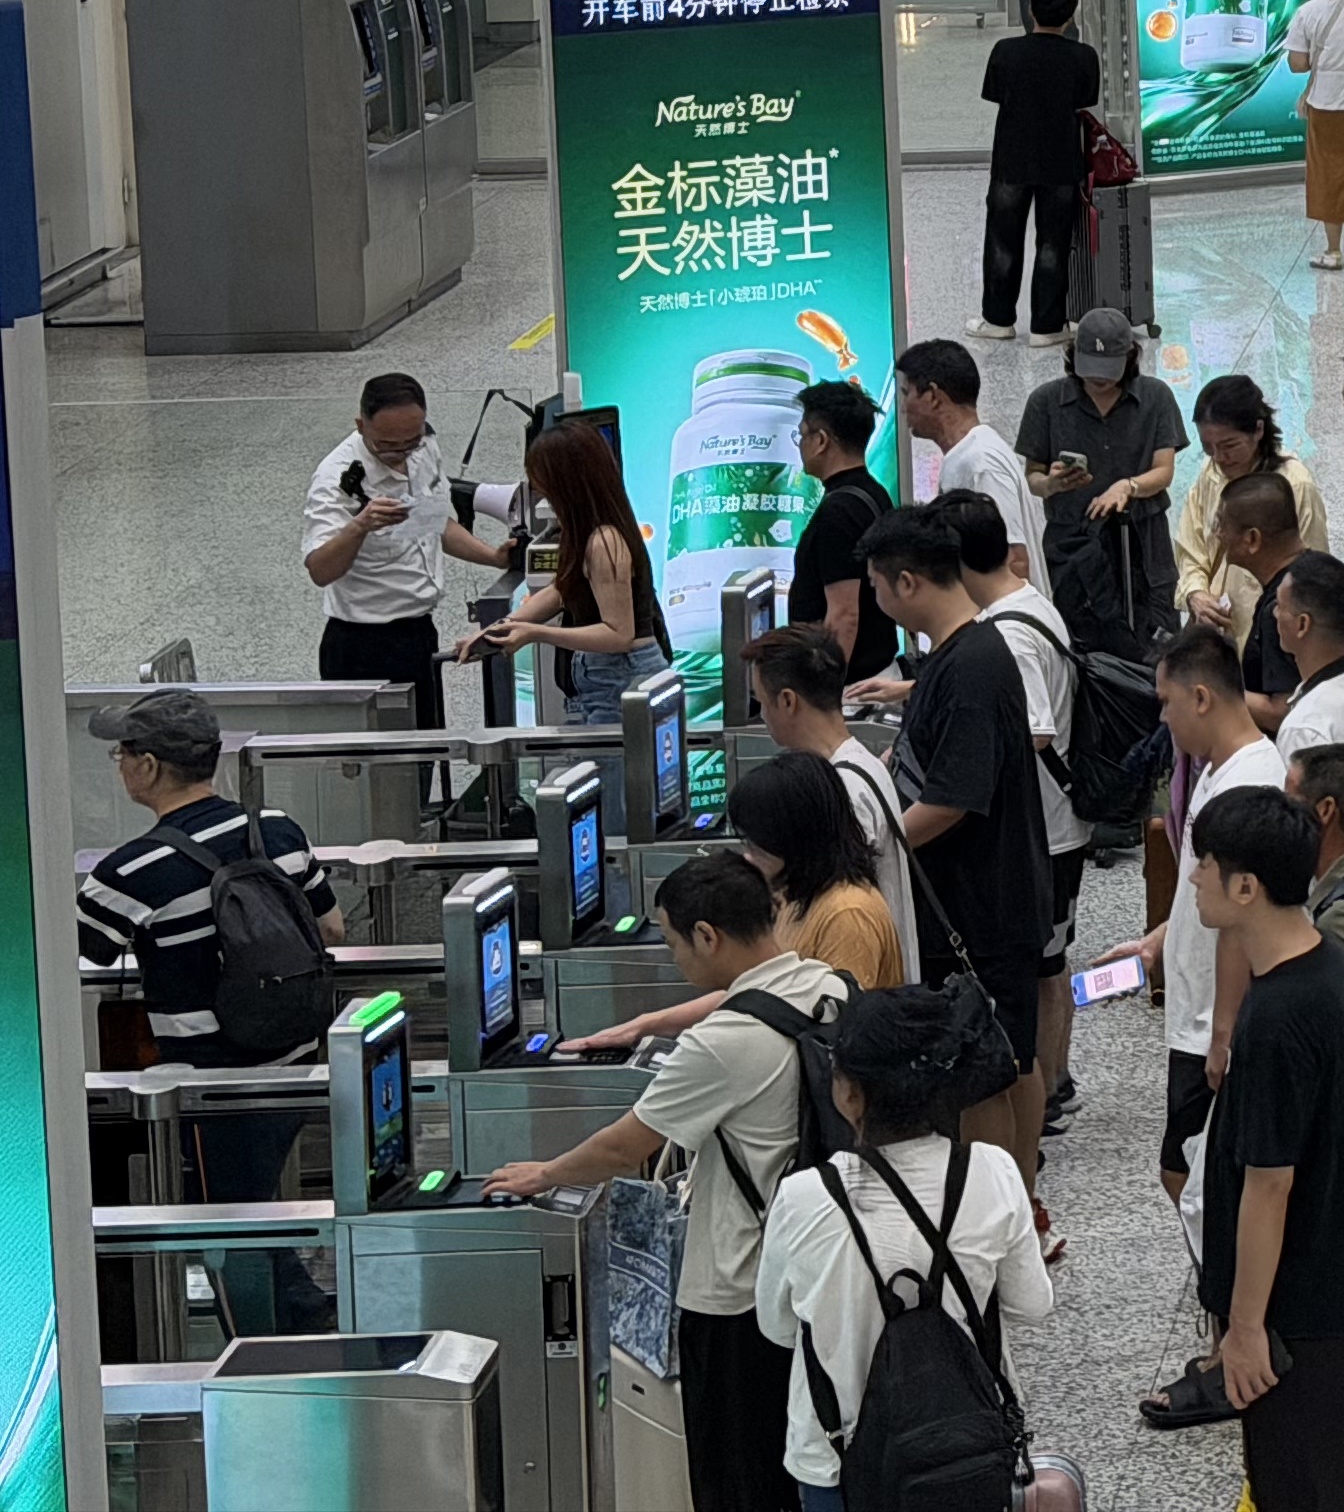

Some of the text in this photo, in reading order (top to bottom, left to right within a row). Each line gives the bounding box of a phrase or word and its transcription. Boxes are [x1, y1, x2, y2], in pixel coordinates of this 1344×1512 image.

[655, 93, 796, 127] Nature's Bay
[616, 209, 834, 281] 天然博士
